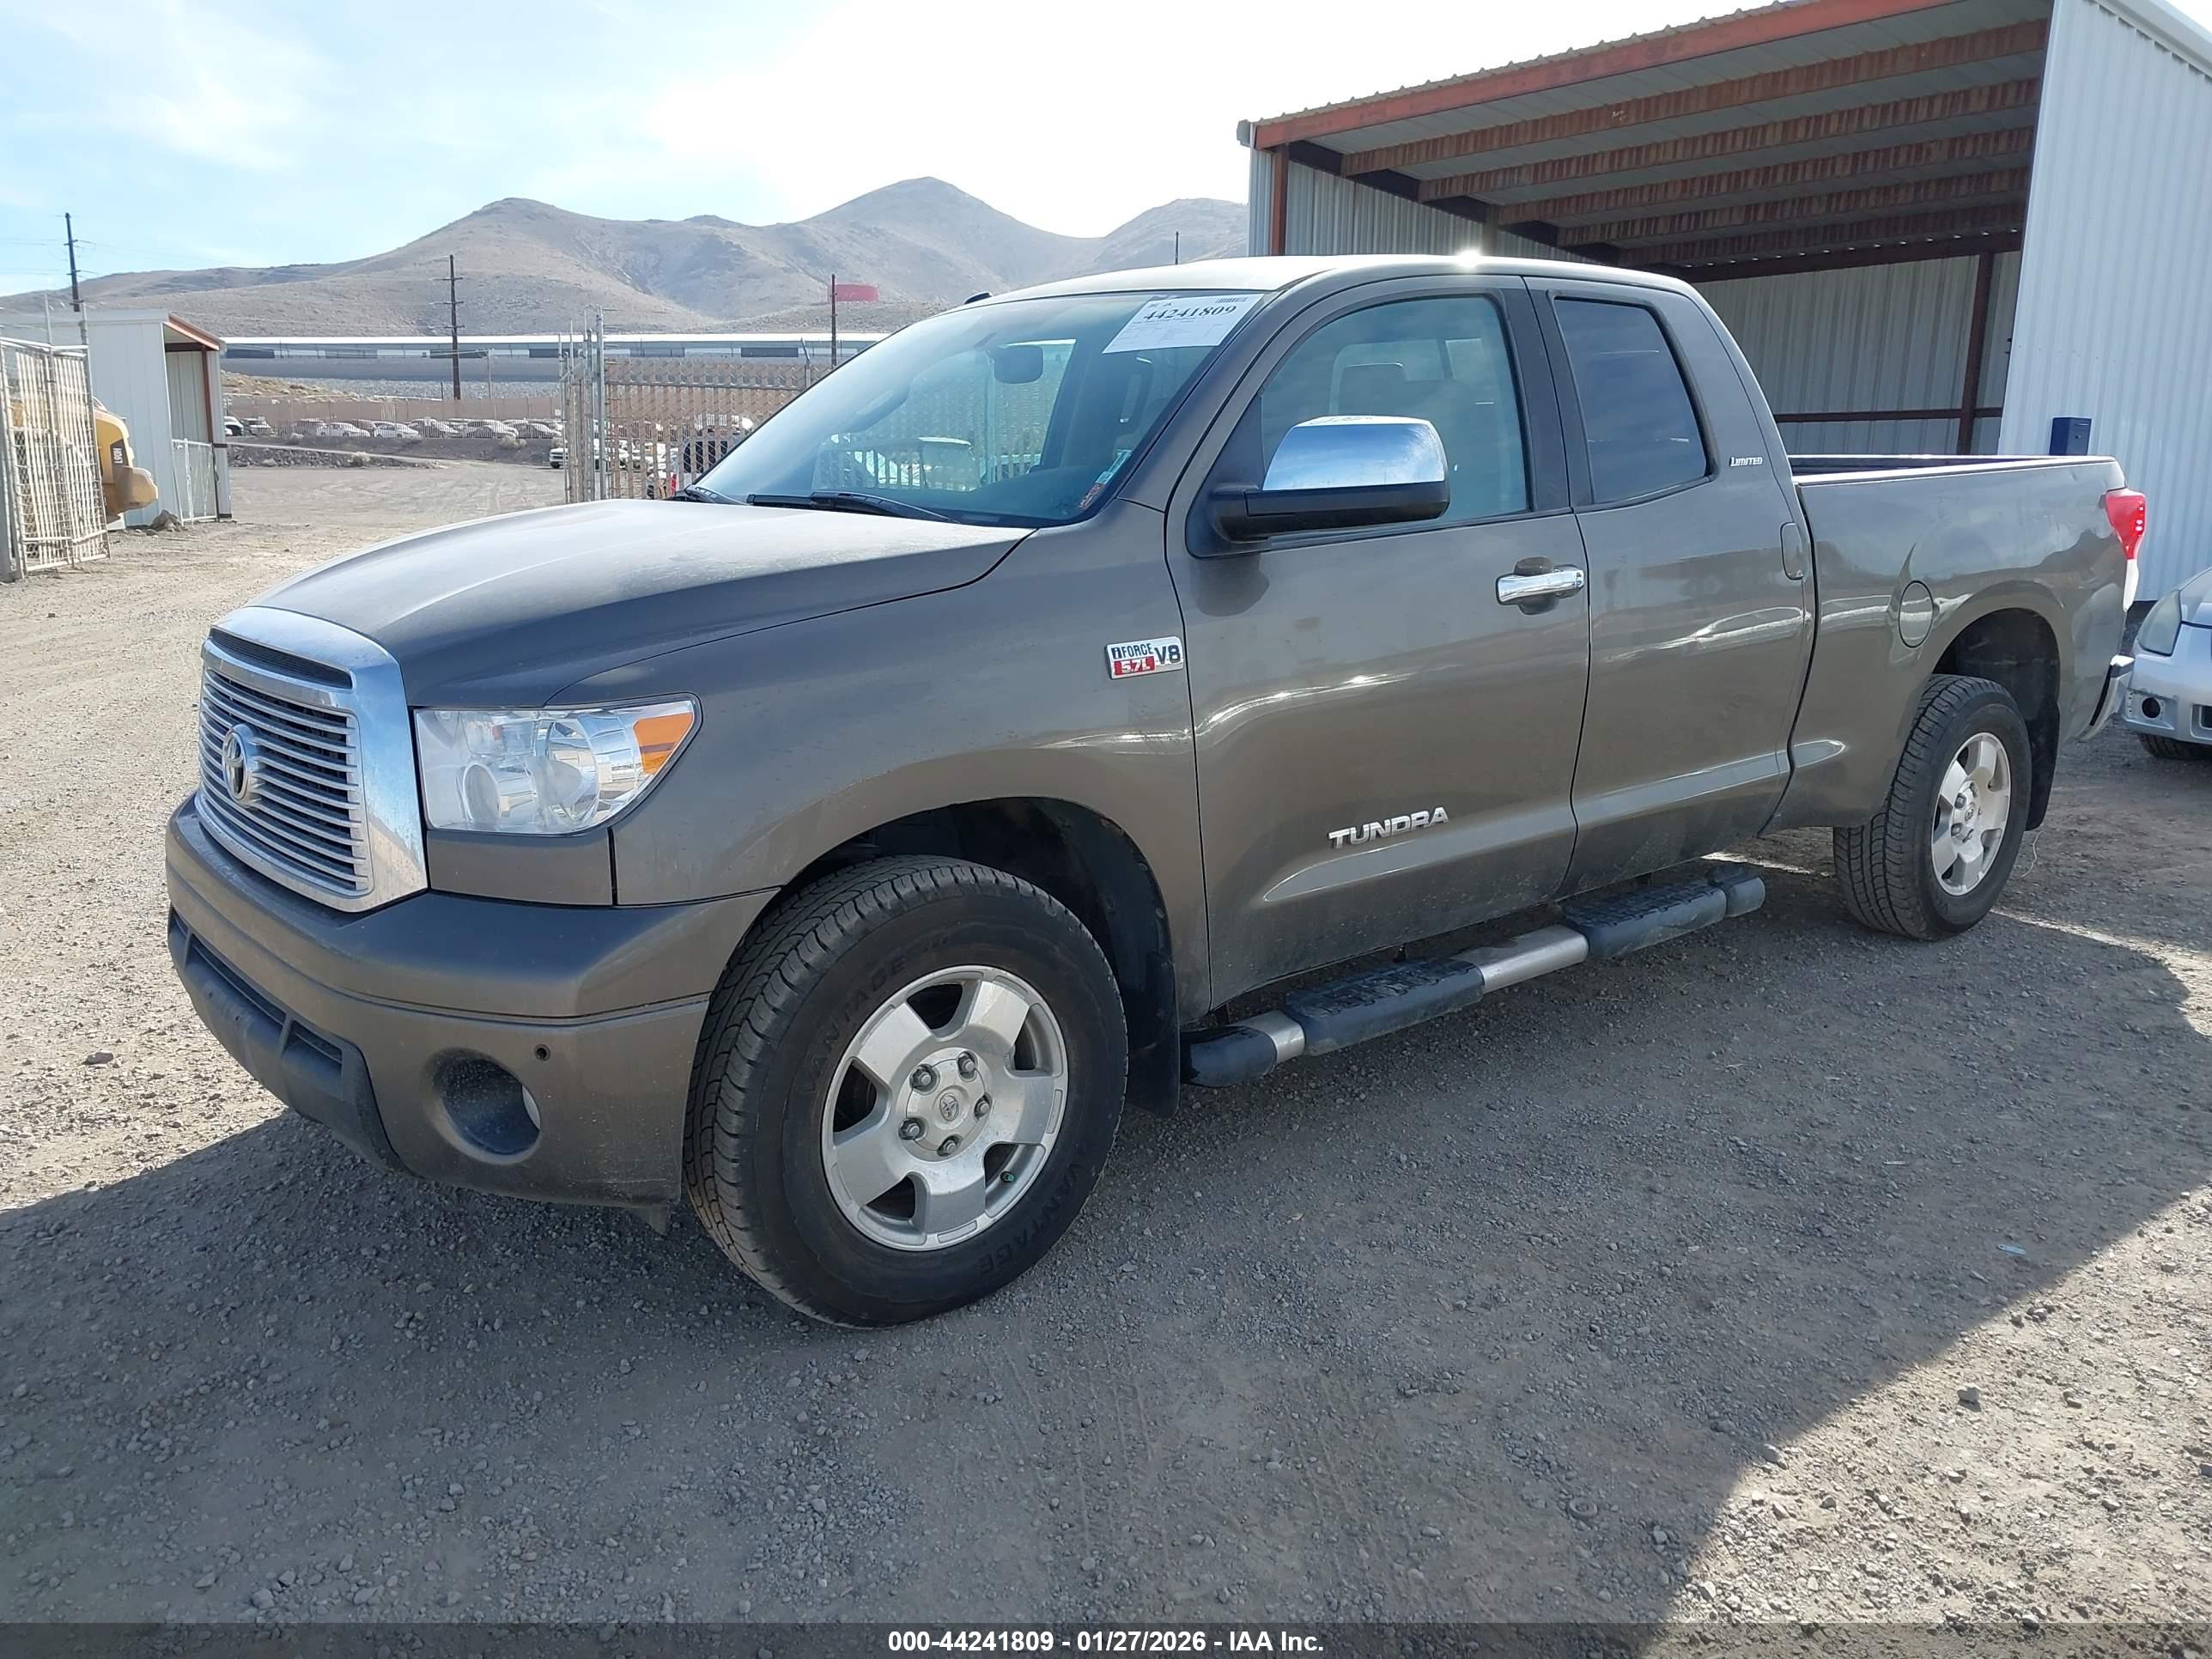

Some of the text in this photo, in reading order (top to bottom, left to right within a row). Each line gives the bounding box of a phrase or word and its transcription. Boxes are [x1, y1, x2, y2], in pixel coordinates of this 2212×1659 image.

[1144, 305, 1237, 320] 44241809
[1155, 644, 1182, 665] V8
[1121, 658, 1151, 673] 5.7L
[1328, 807, 1449, 850] TUNDRA
